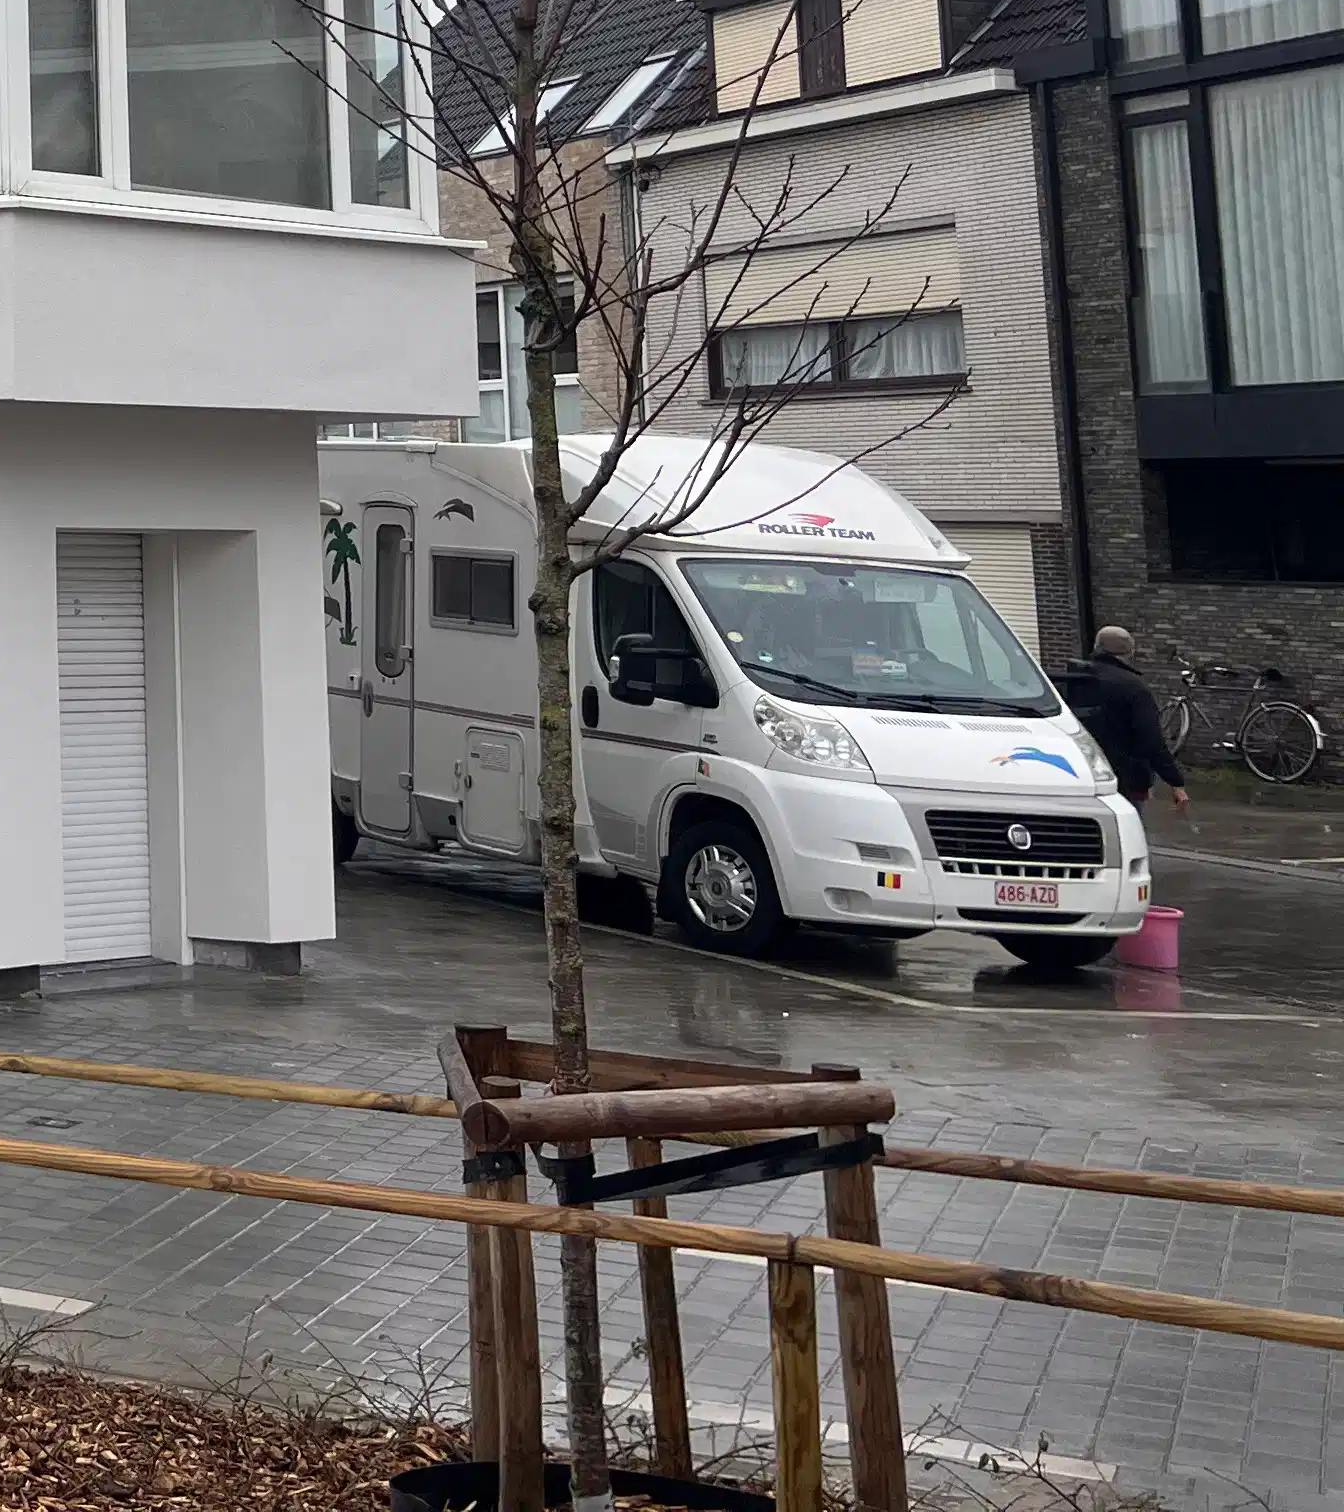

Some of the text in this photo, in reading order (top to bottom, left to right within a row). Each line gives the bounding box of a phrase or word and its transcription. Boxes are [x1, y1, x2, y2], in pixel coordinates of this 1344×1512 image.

[758, 523, 876, 541] ROLLER TEAM
[998, 884, 1057, 904] 486-AZD
